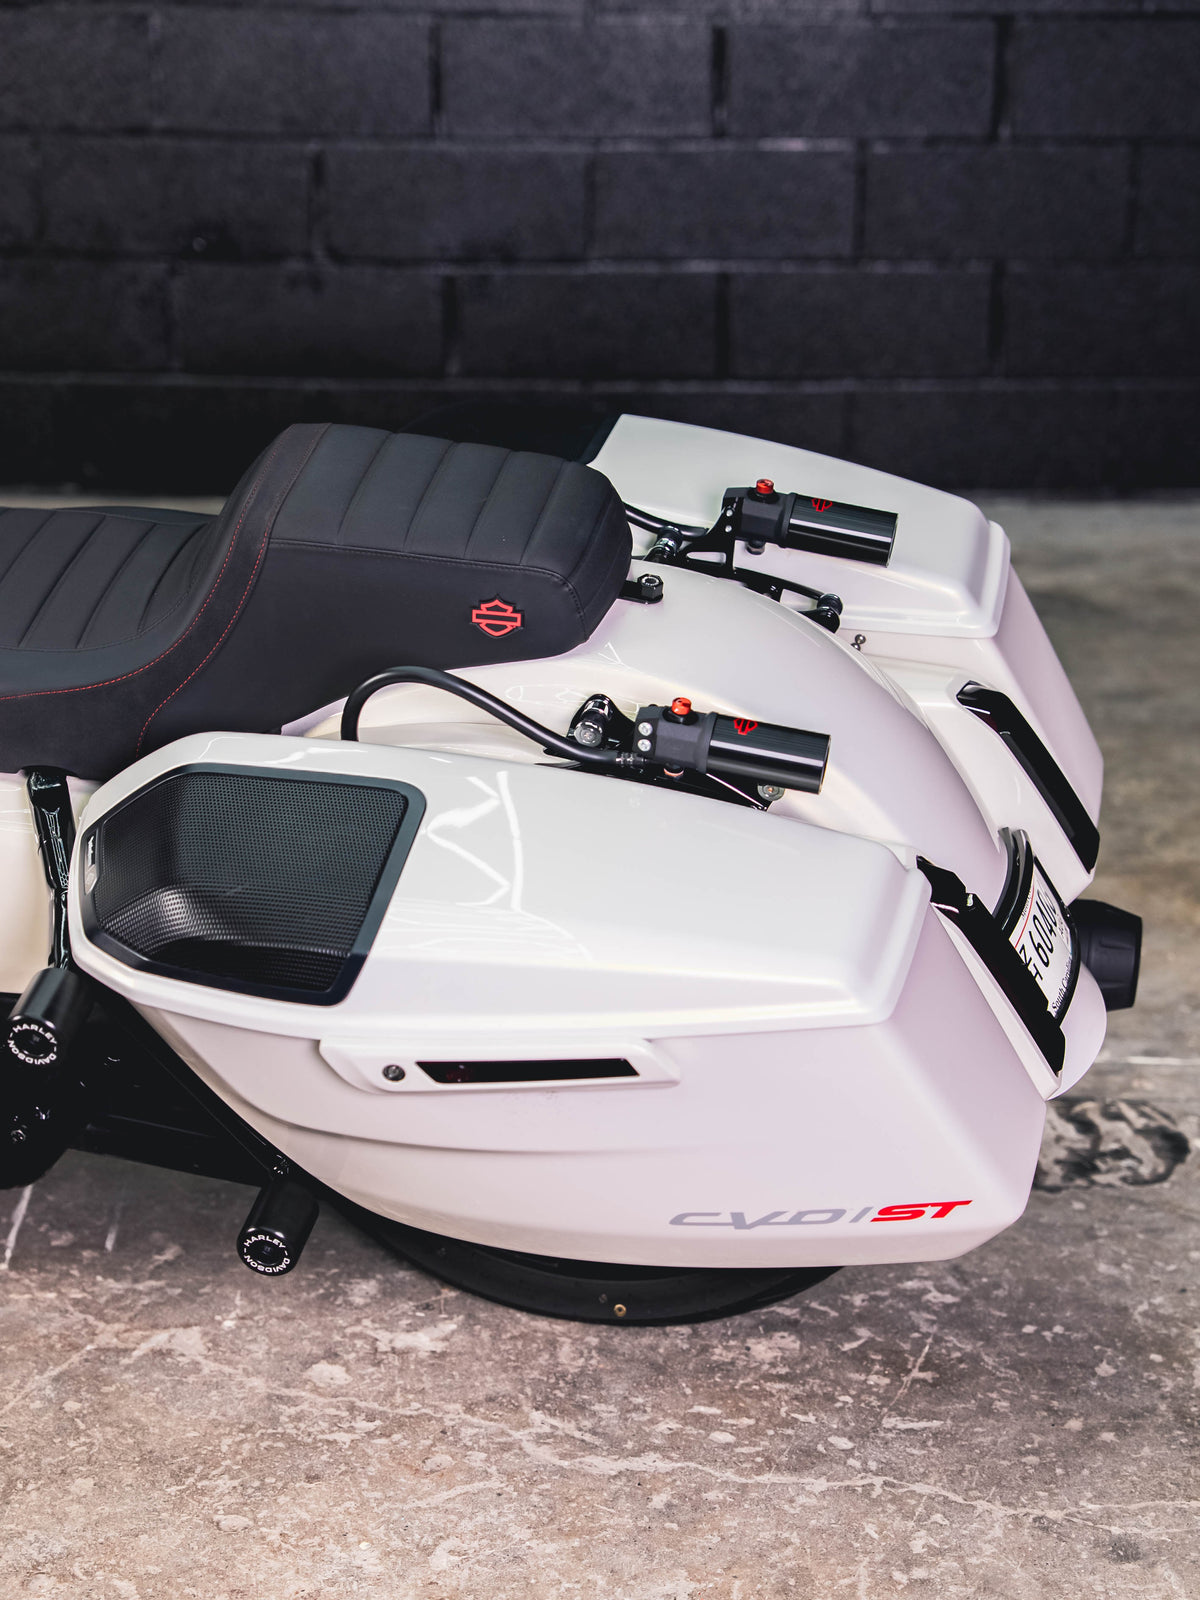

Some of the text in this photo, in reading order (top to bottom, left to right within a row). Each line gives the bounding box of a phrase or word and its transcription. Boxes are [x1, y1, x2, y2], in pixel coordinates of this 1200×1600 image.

[1052, 987, 1067, 1011] South
[8, 1023, 57, 1065] HARLEY DAVIDSON
[243, 1234, 291, 1273] HARLEY DAVIDSON
